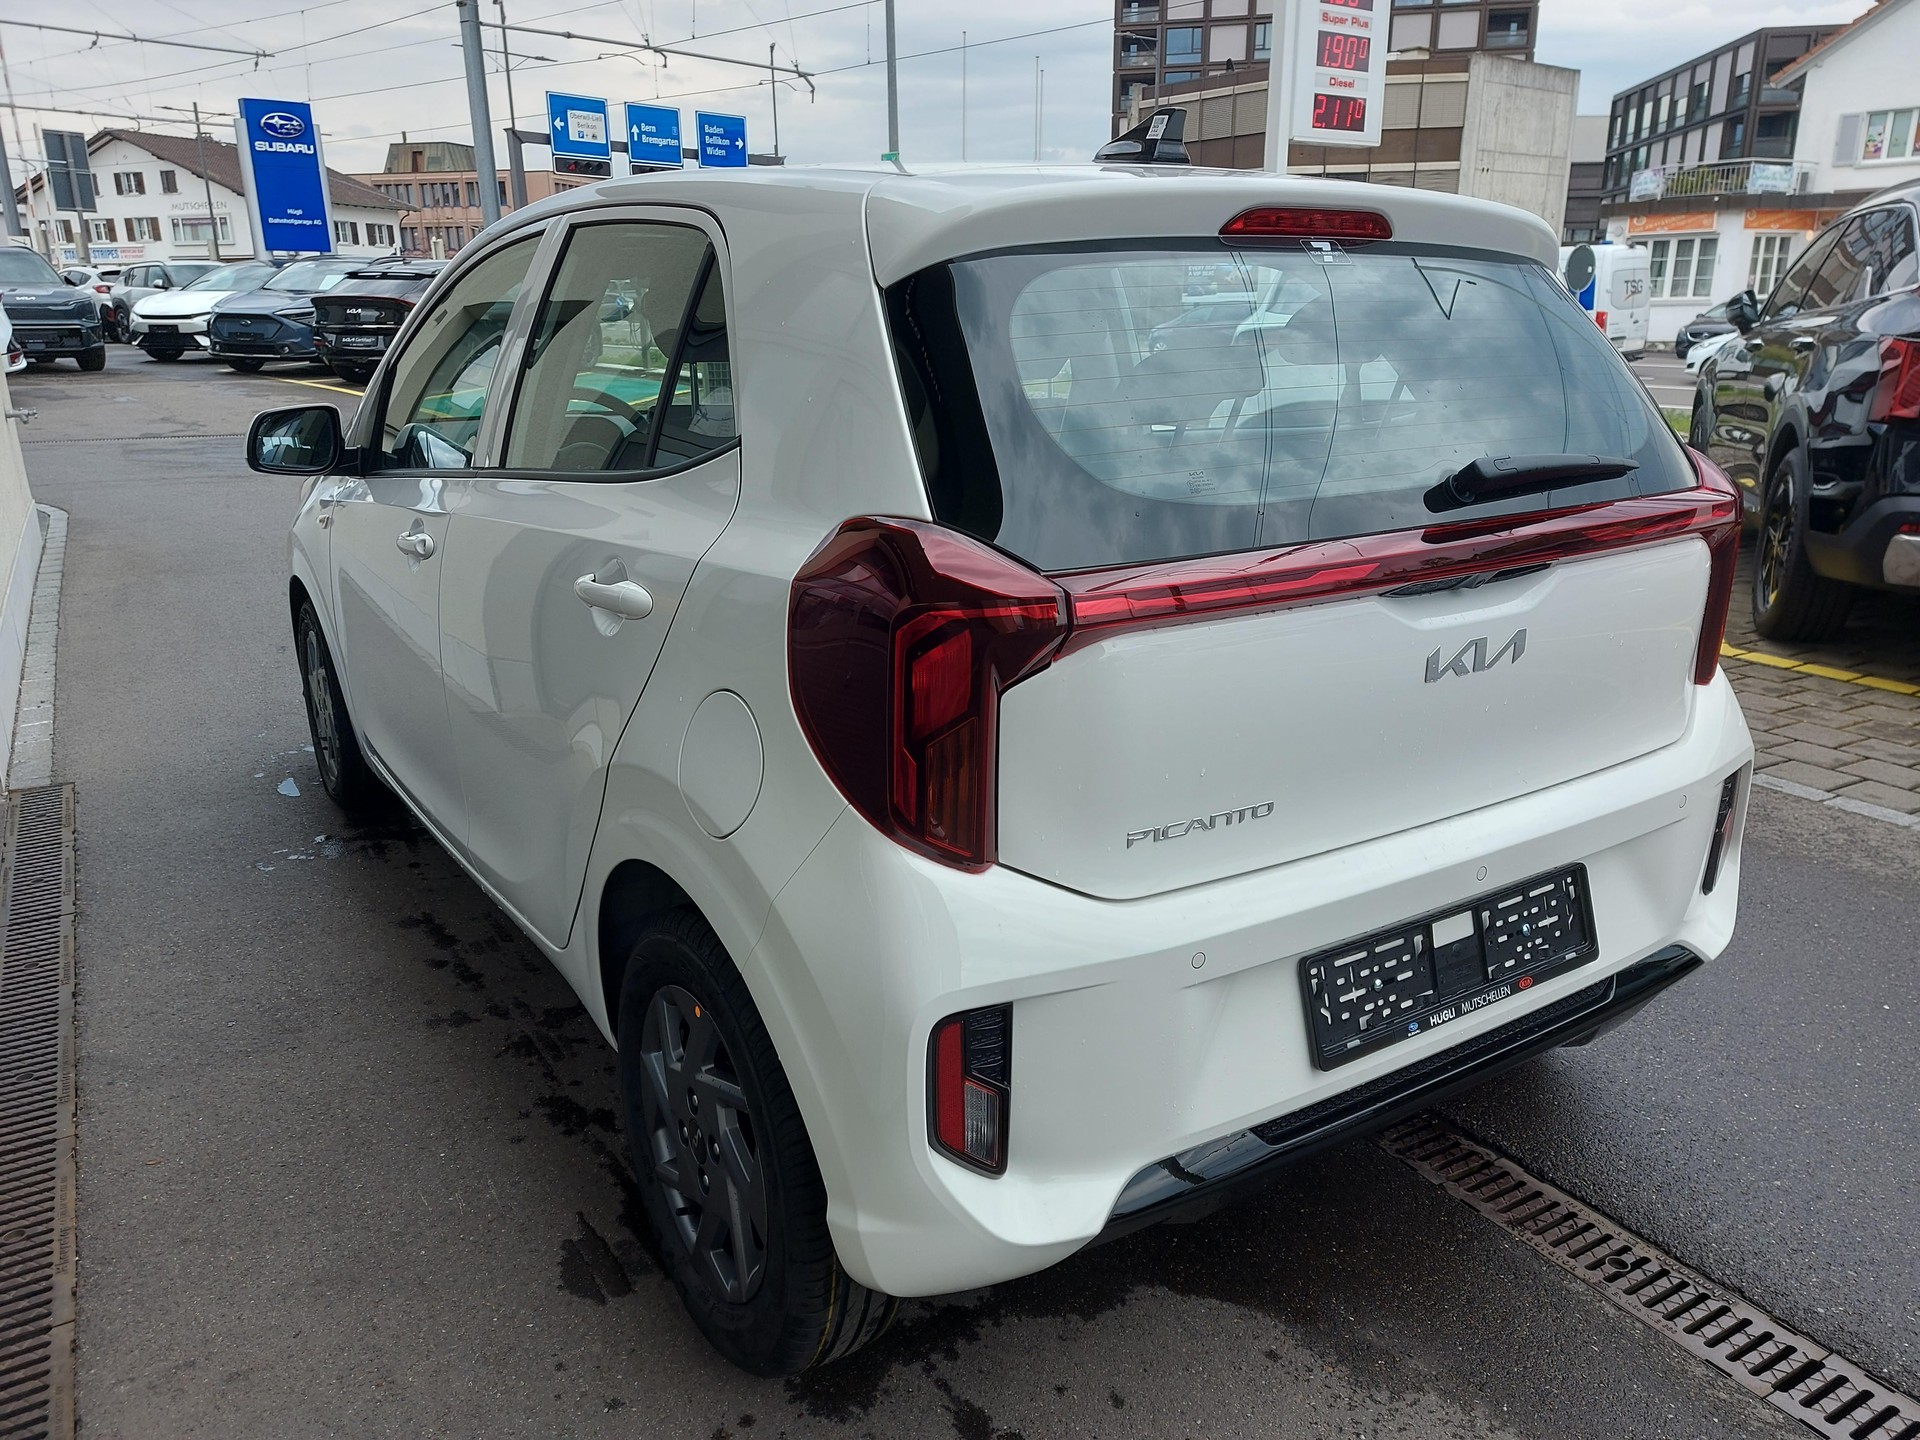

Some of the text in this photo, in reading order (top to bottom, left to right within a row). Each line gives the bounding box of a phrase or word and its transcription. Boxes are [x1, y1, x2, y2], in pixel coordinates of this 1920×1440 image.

[1322, 12, 1369, 28] Super Plus
[1329, 77, 1355, 88] Diesel
[641, 122, 656, 132] Bern
[704, 124, 724, 134] Baden
[642, 134, 679, 147] Bremgarten
[705, 135, 730, 146] Bellikon
[254, 141, 314, 154] SUBARU
[706, 146, 726, 156] Widen
[171, 201, 227, 211] MUTSCHELEN
[1624, 279, 1644, 295] TSG
[1424, 627, 1528, 684] KIA
[1126, 800, 1275, 849] PICANTO
[1461, 984, 1512, 1015] MUTSCHELLEN
